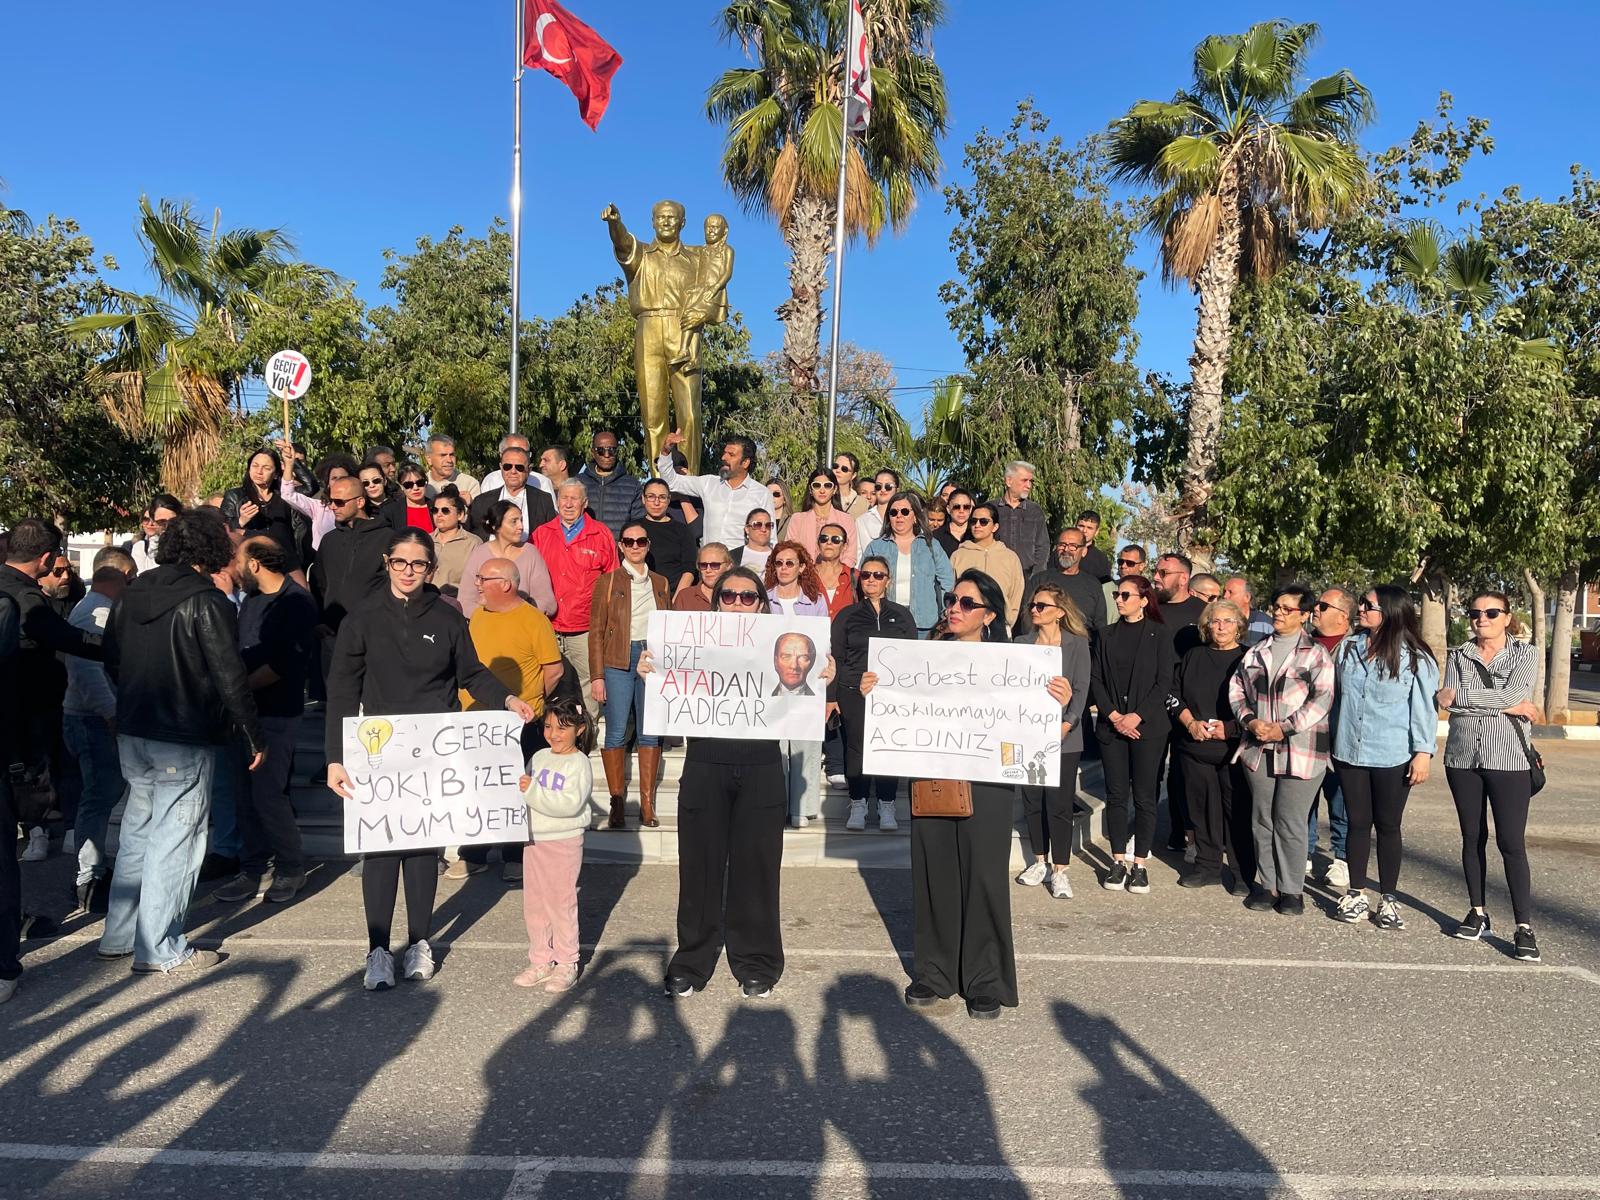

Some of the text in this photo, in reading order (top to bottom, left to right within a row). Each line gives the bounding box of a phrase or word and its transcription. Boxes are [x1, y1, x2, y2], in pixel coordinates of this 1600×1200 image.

[663, 612, 758, 648] LAİKLİK
[659, 669, 764, 698] ATA'DAN
[877, 645, 978, 689] Serbest
[870, 693, 1011, 730] baskılanmaya
[431, 722, 522, 757] GEREK
[355, 771, 432, 806] YOK!
[357, 804, 528, 850] MUM YETER
